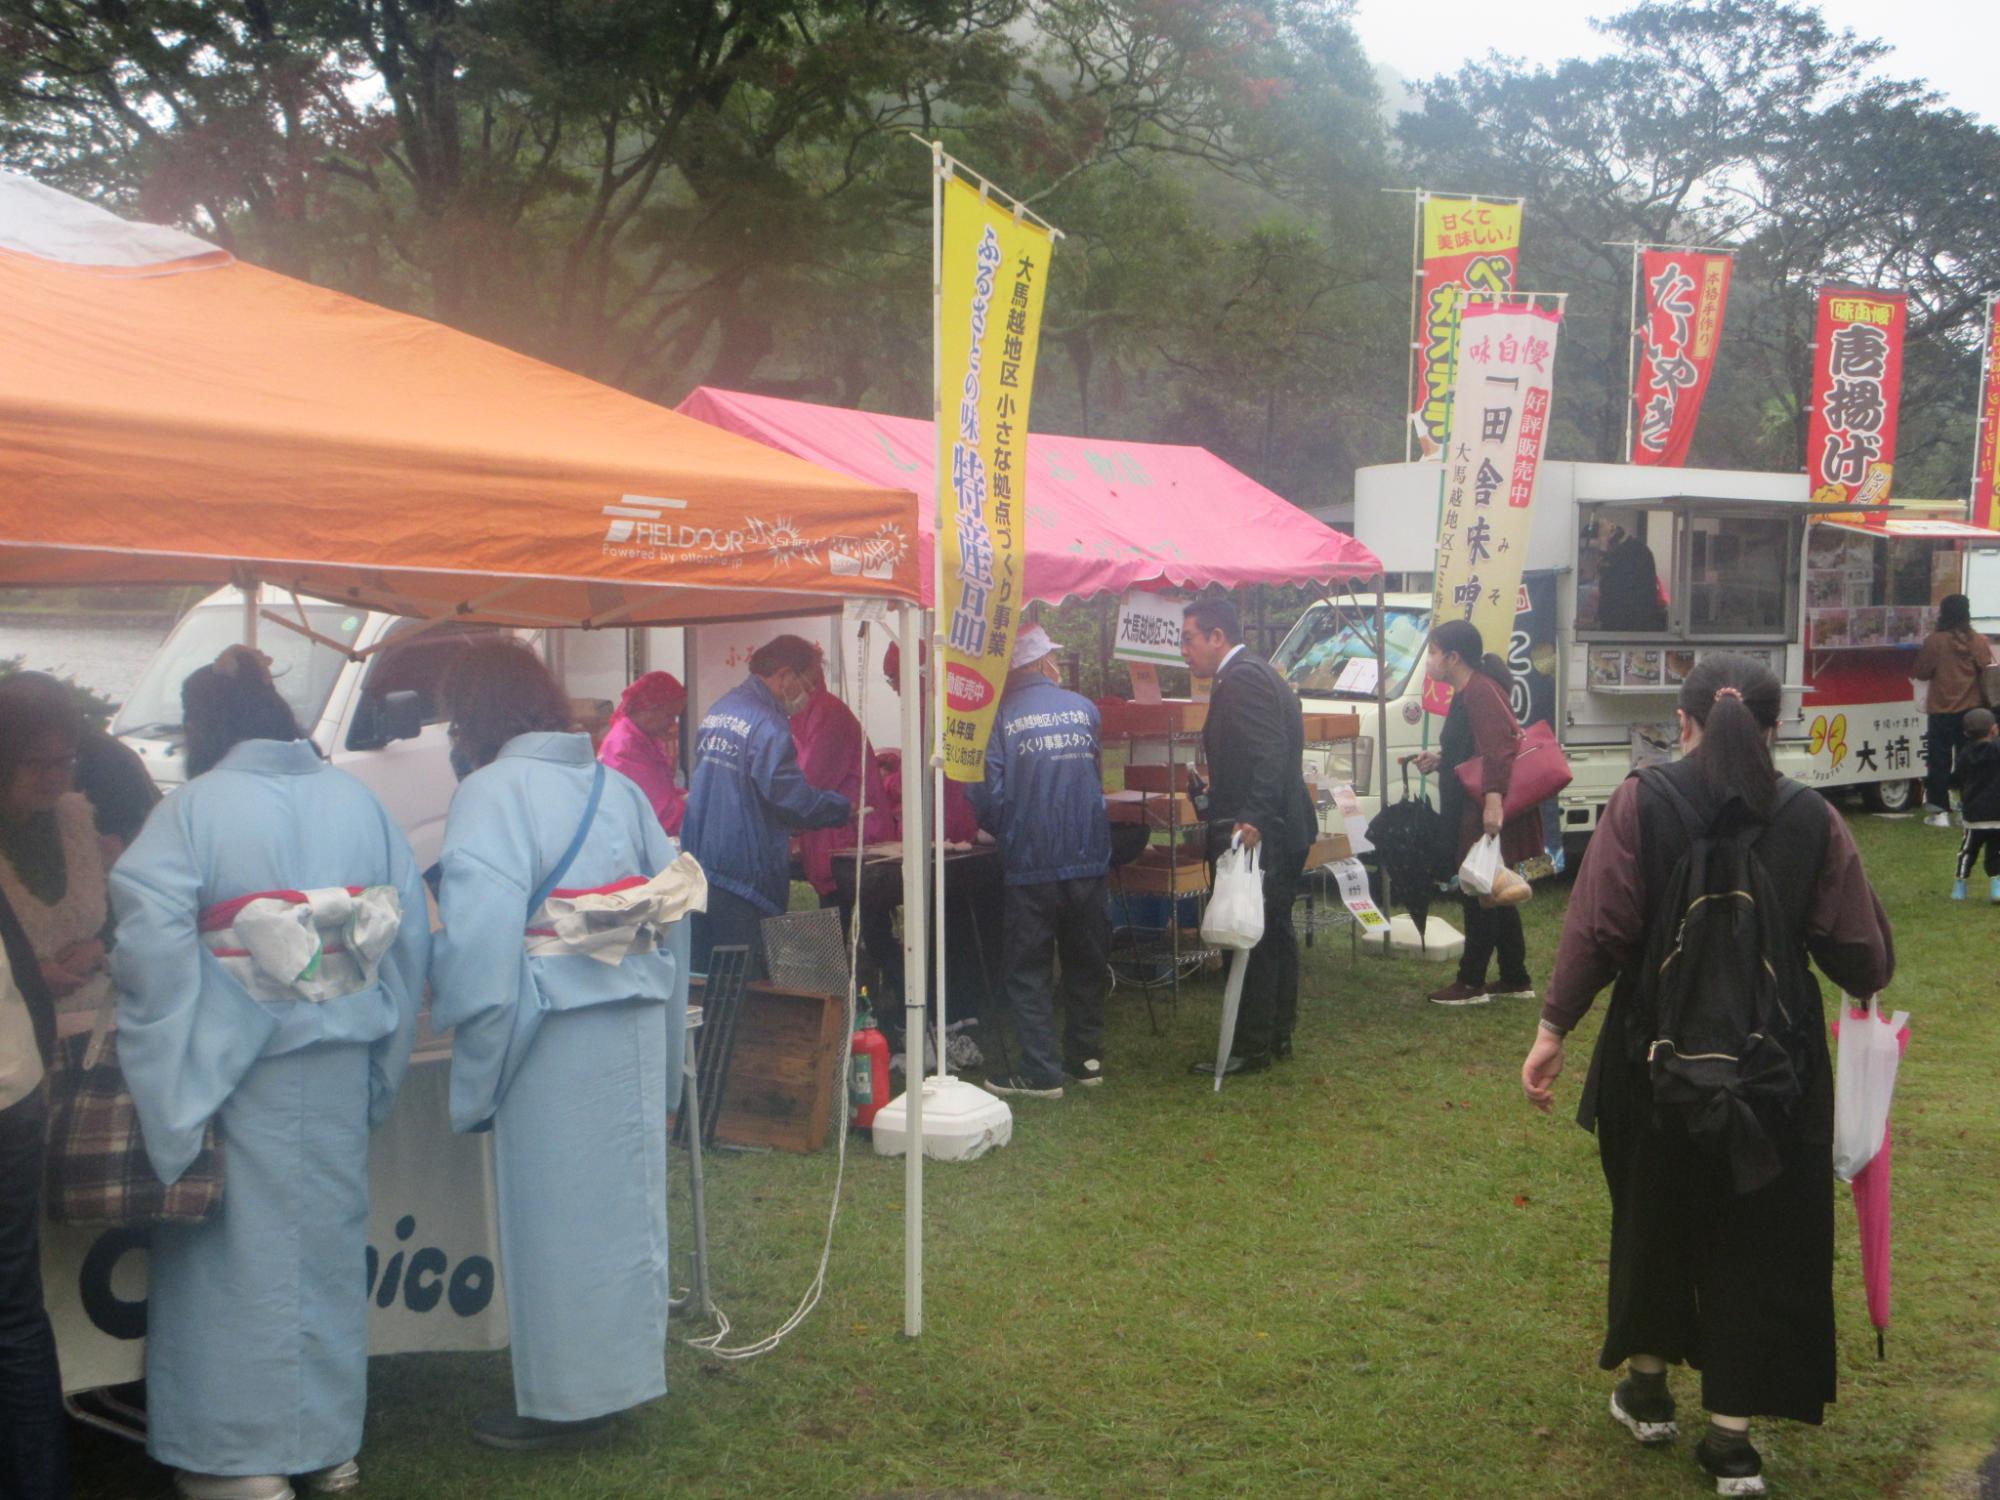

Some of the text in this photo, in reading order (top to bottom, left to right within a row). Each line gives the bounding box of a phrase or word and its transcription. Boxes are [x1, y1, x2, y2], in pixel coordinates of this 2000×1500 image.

[1441, 209, 1492, 231] 甘くて
[1469, 333, 1551, 374] 味自慢
[1641, 262, 1699, 452] たいやき
[1821, 324, 1889, 487] 唐揚げ
[1510, 391, 1547, 504] 好評販売中
[602, 543, 655, 560] Powered
[660, 549, 676, 563] by
[636, 522, 745, 553] FIELDOOR
